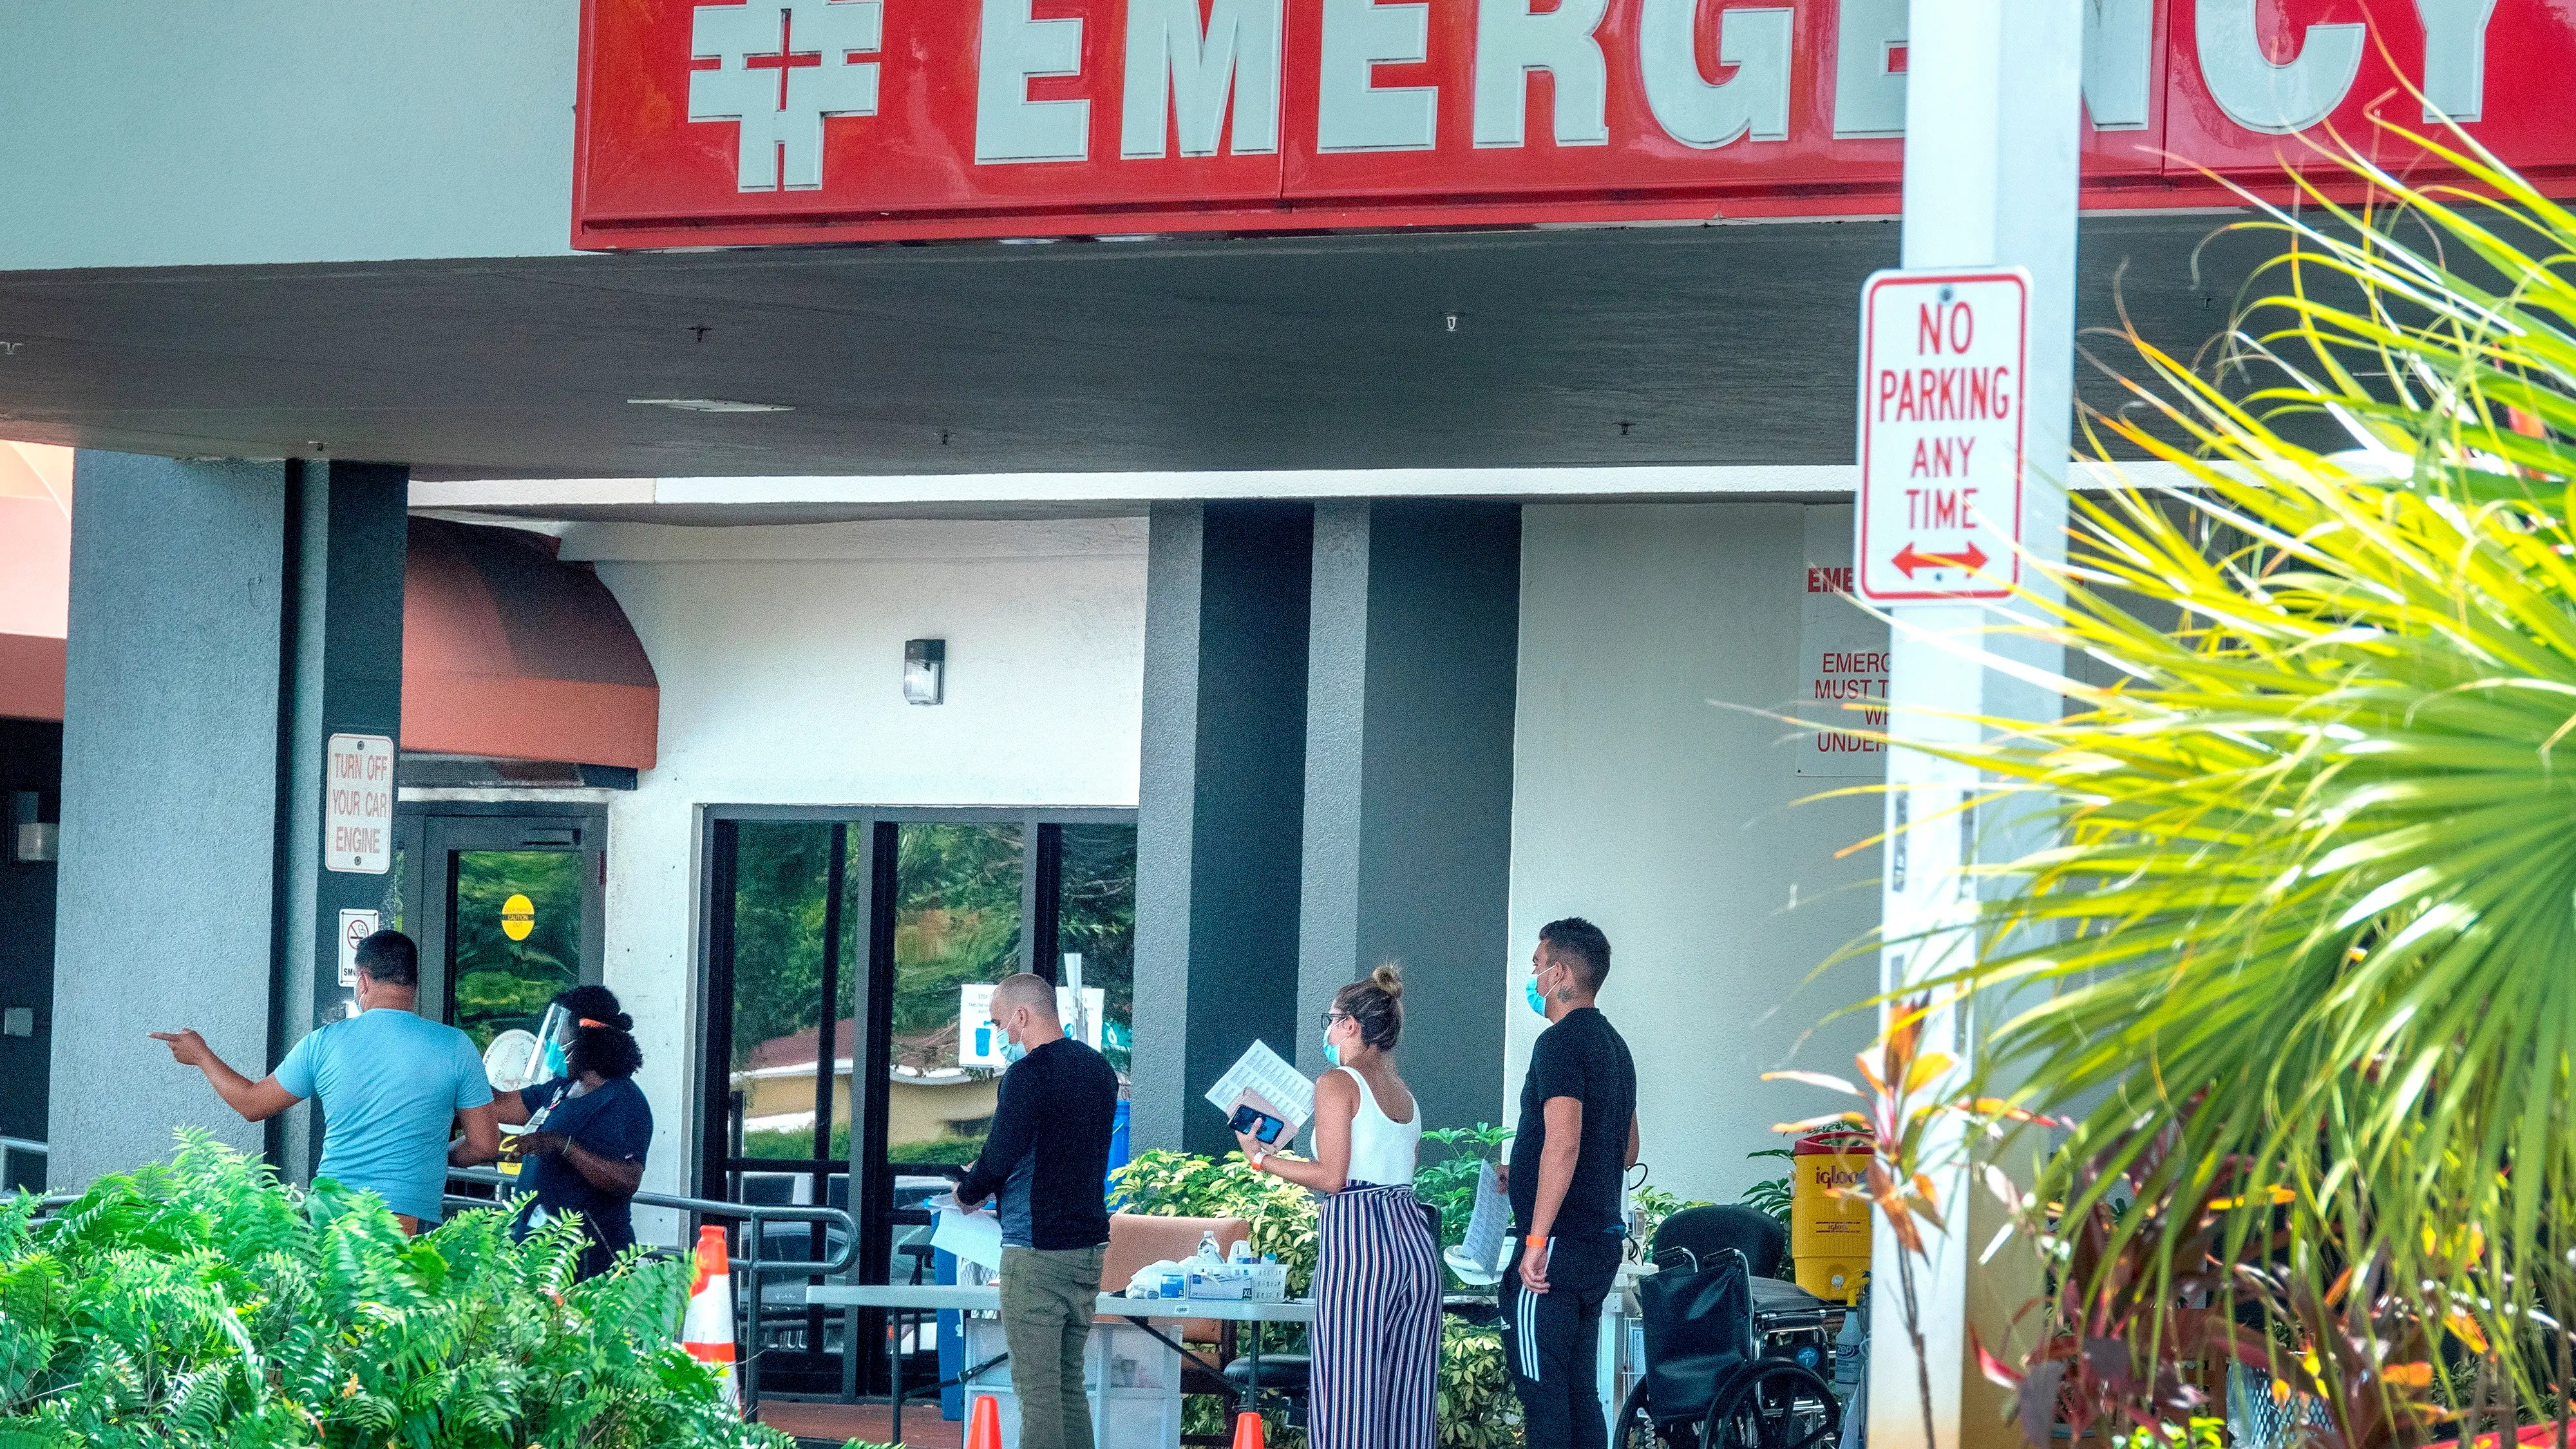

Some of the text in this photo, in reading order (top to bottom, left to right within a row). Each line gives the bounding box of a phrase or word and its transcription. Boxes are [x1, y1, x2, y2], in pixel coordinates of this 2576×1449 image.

[974, 0, 2486, 166] EMERGCY
[1917, 301, 1974, 355] NO
[1879, 366, 2010, 422] PARKING
[1909, 436, 1976, 478] ANY
[1904, 488, 1979, 530] TIME
[1814, 679, 1872, 699] MUST
[334, 753, 387, 782] TURN OFF
[332, 789, 387, 818] YOUR CAR
[336, 826, 381, 854] ENGINE
[1815, 1165, 1859, 1189] igloo
[1243, 1288, 1252, 1297] XL
